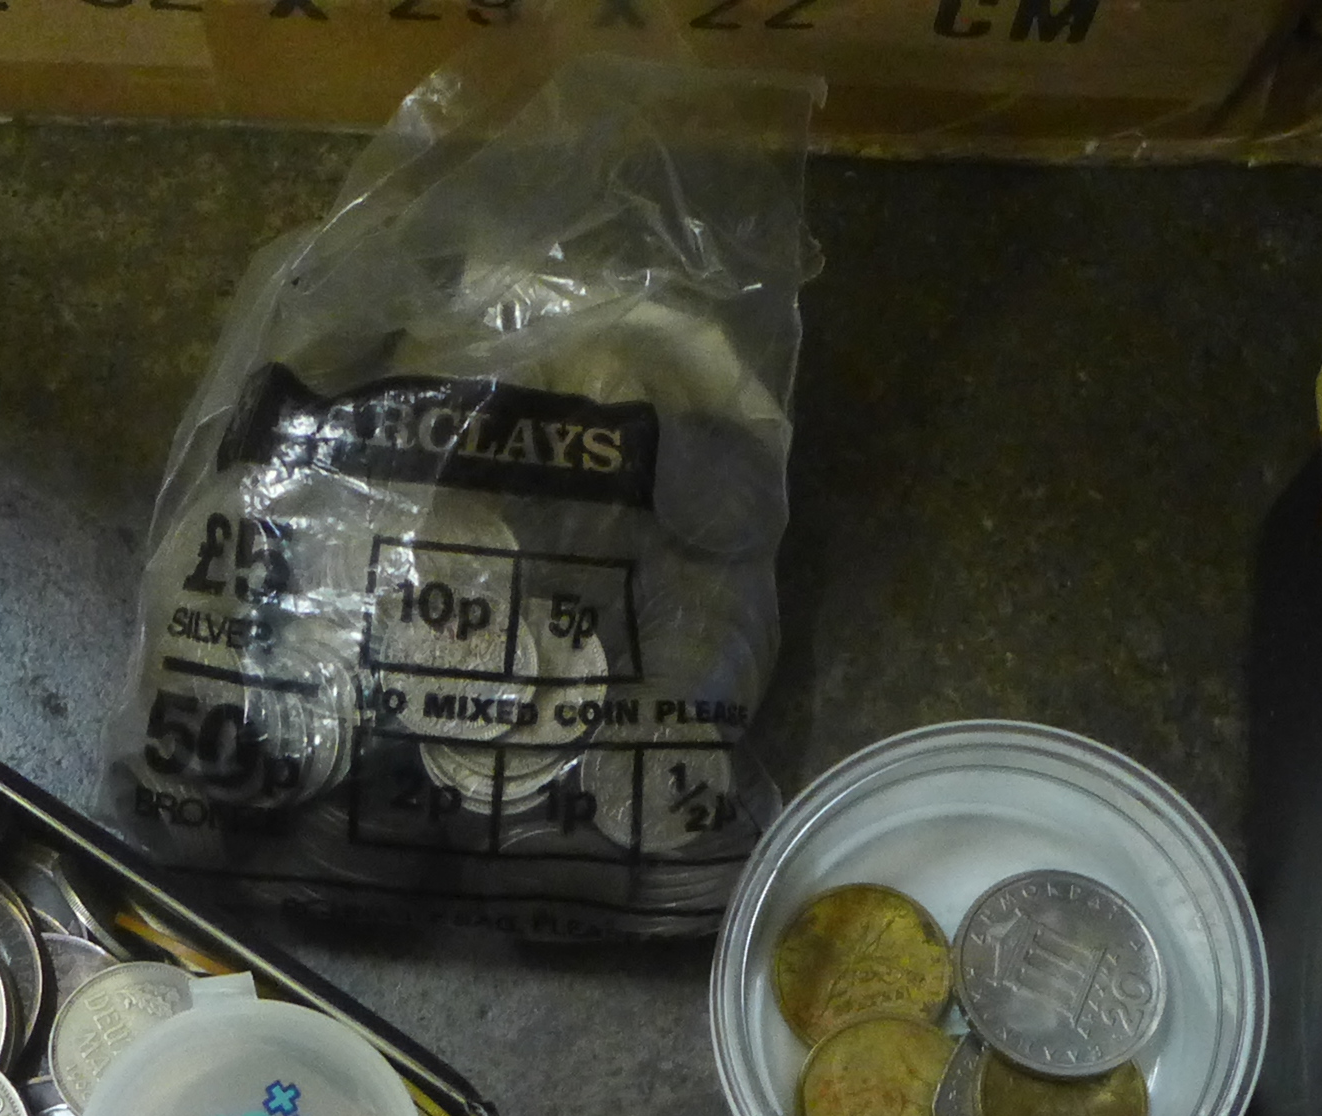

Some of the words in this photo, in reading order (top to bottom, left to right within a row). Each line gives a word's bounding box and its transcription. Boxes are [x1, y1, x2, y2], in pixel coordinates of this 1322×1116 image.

[183, 512, 291, 602] £5
[397, 580, 491, 643] 10p
[549, 594, 599, 649] 5p
[423, 692, 539, 727] MIXED
[554, 696, 639, 727] COIN
